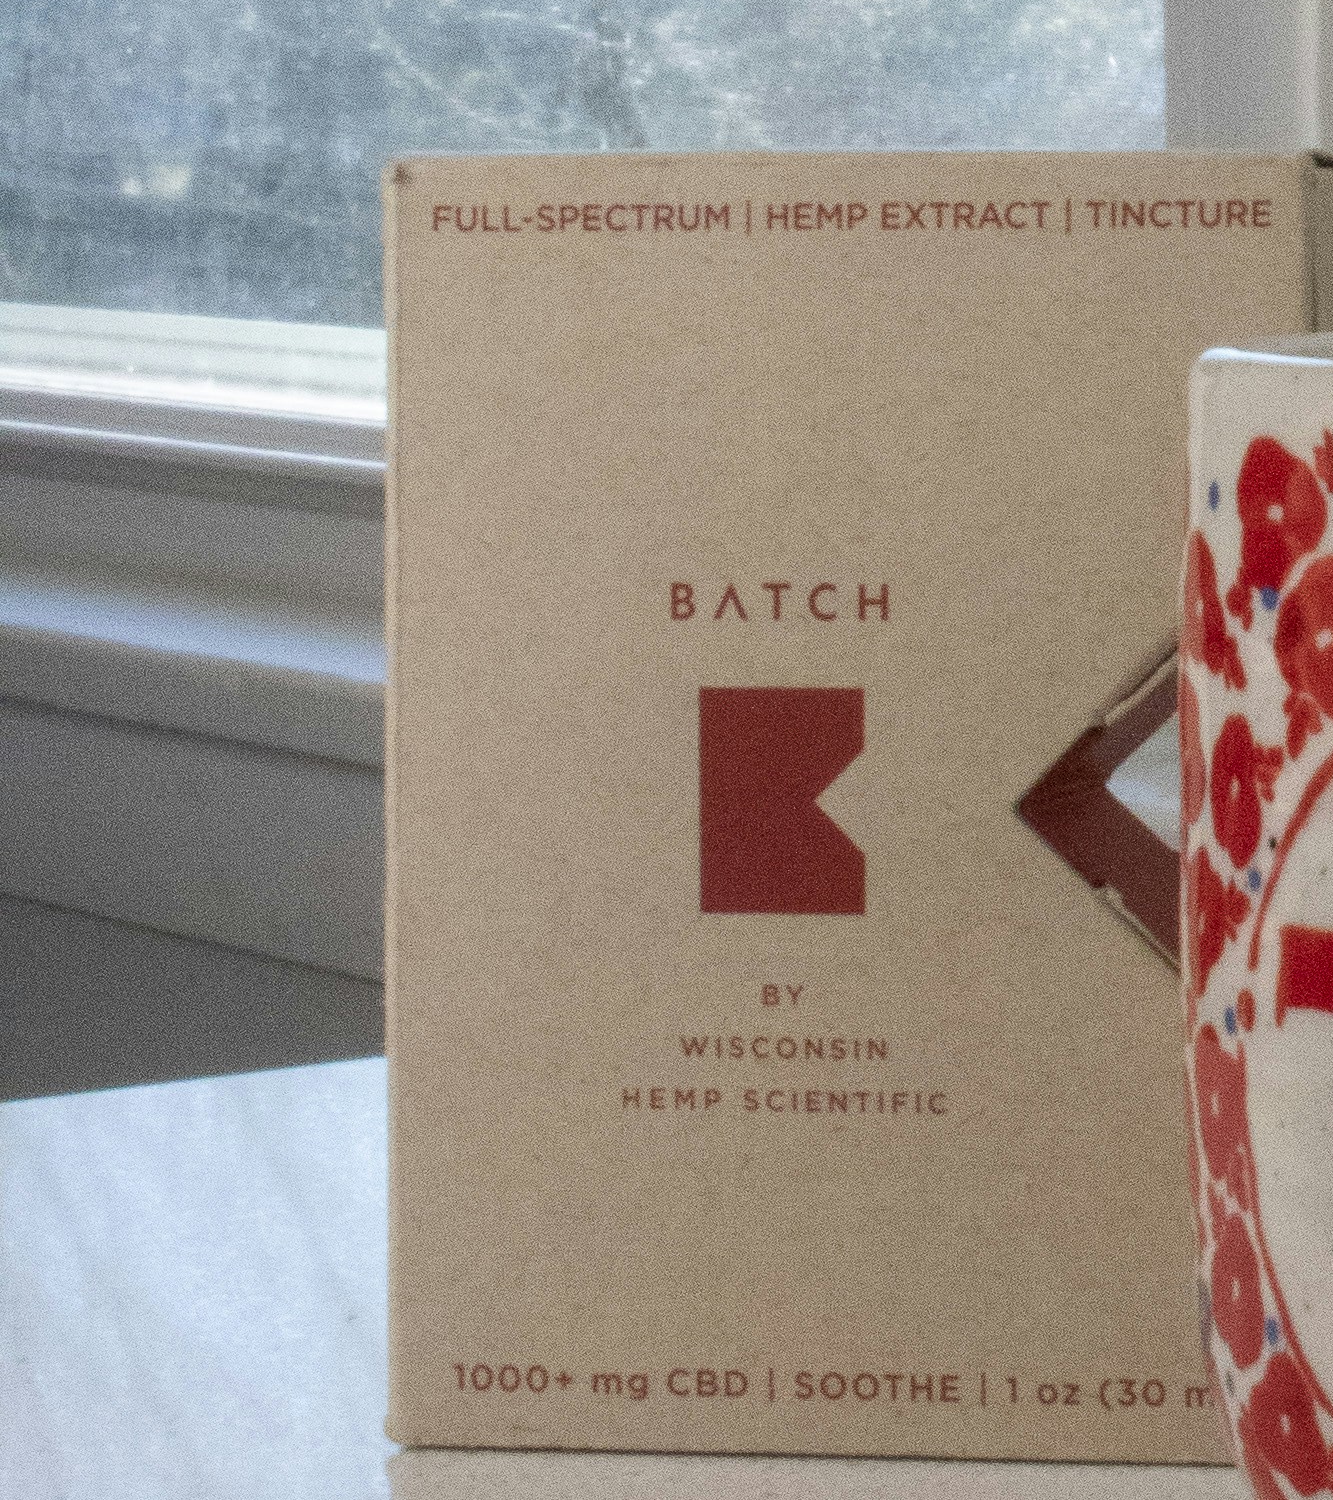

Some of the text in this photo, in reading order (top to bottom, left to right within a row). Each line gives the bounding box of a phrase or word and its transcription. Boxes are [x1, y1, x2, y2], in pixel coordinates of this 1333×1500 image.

[431, 198, 1275, 234] FULL-SPECTRUM HEMP EXTRACT TINCTURE
[669, 581, 890, 622] BATCH
[761, 983, 805, 1007] BY
[680, 1034, 889, 1061] WISCONSIN
[620, 1086, 948, 1116] HEMP SCIENTIFIC
[452, 1362, 575, 1394] 1000+
[590, 1371, 651, 1402] mg
[666, 1367, 750, 1398] CBD
[794, 1371, 960, 1403] SOOTHE
[1036, 1381, 1081, 1407] oz
[1098, 1377, 1166, 1413] (30
